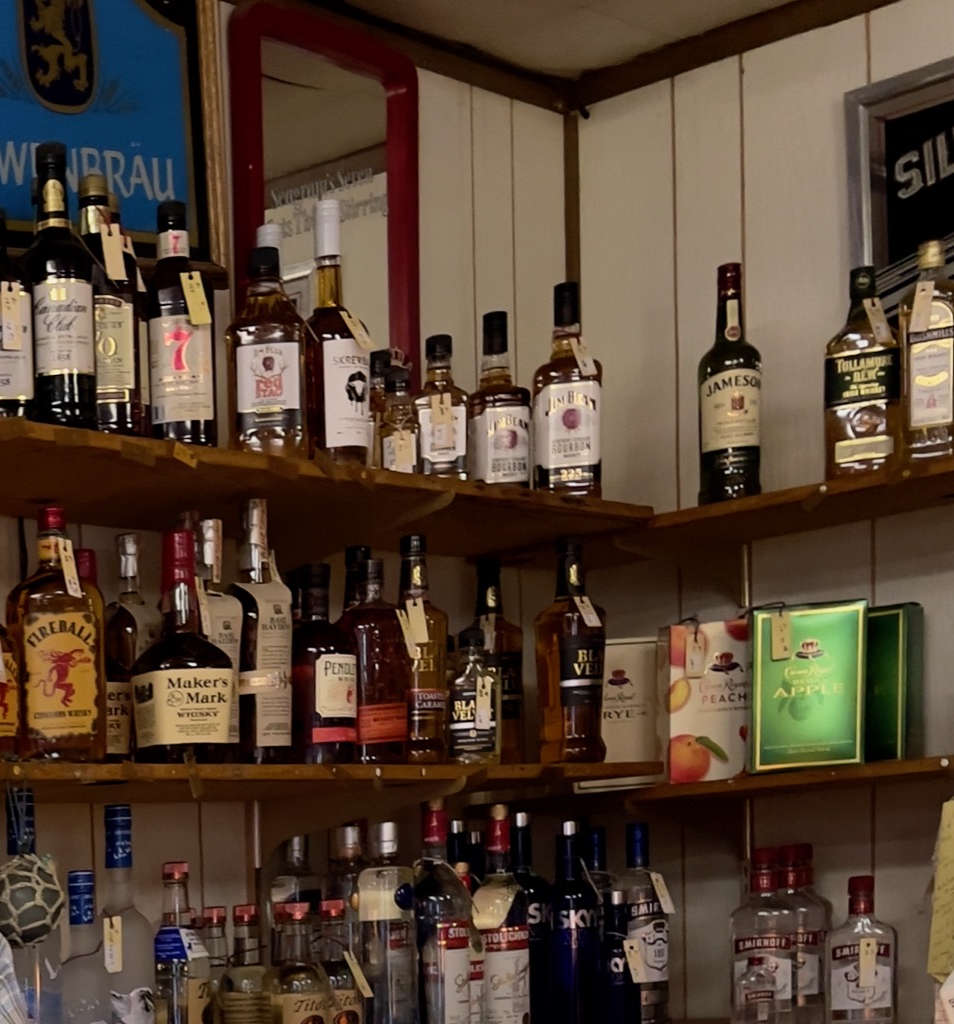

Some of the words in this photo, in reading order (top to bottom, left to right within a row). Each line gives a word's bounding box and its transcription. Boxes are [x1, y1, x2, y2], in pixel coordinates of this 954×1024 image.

[164, 328, 194, 372] 7
[256, 373, 283, 388] red
[255, 387, 283, 399] STAG
[552, 440, 591, 454] BOURBON
[492, 460, 527, 473] BOURBON
[27, 620, 97, 649] FIREBALL
[166, 677, 229, 690] Maker's
[773, 683, 845, 698] APPLE
[185, 692, 227, 704] Mark
[701, 692, 747, 705] PEACH
[454, 701, 476, 711] BLA
[603, 709, 635, 720] RYE
[737, 936, 788, 951] SMIRNOFF
